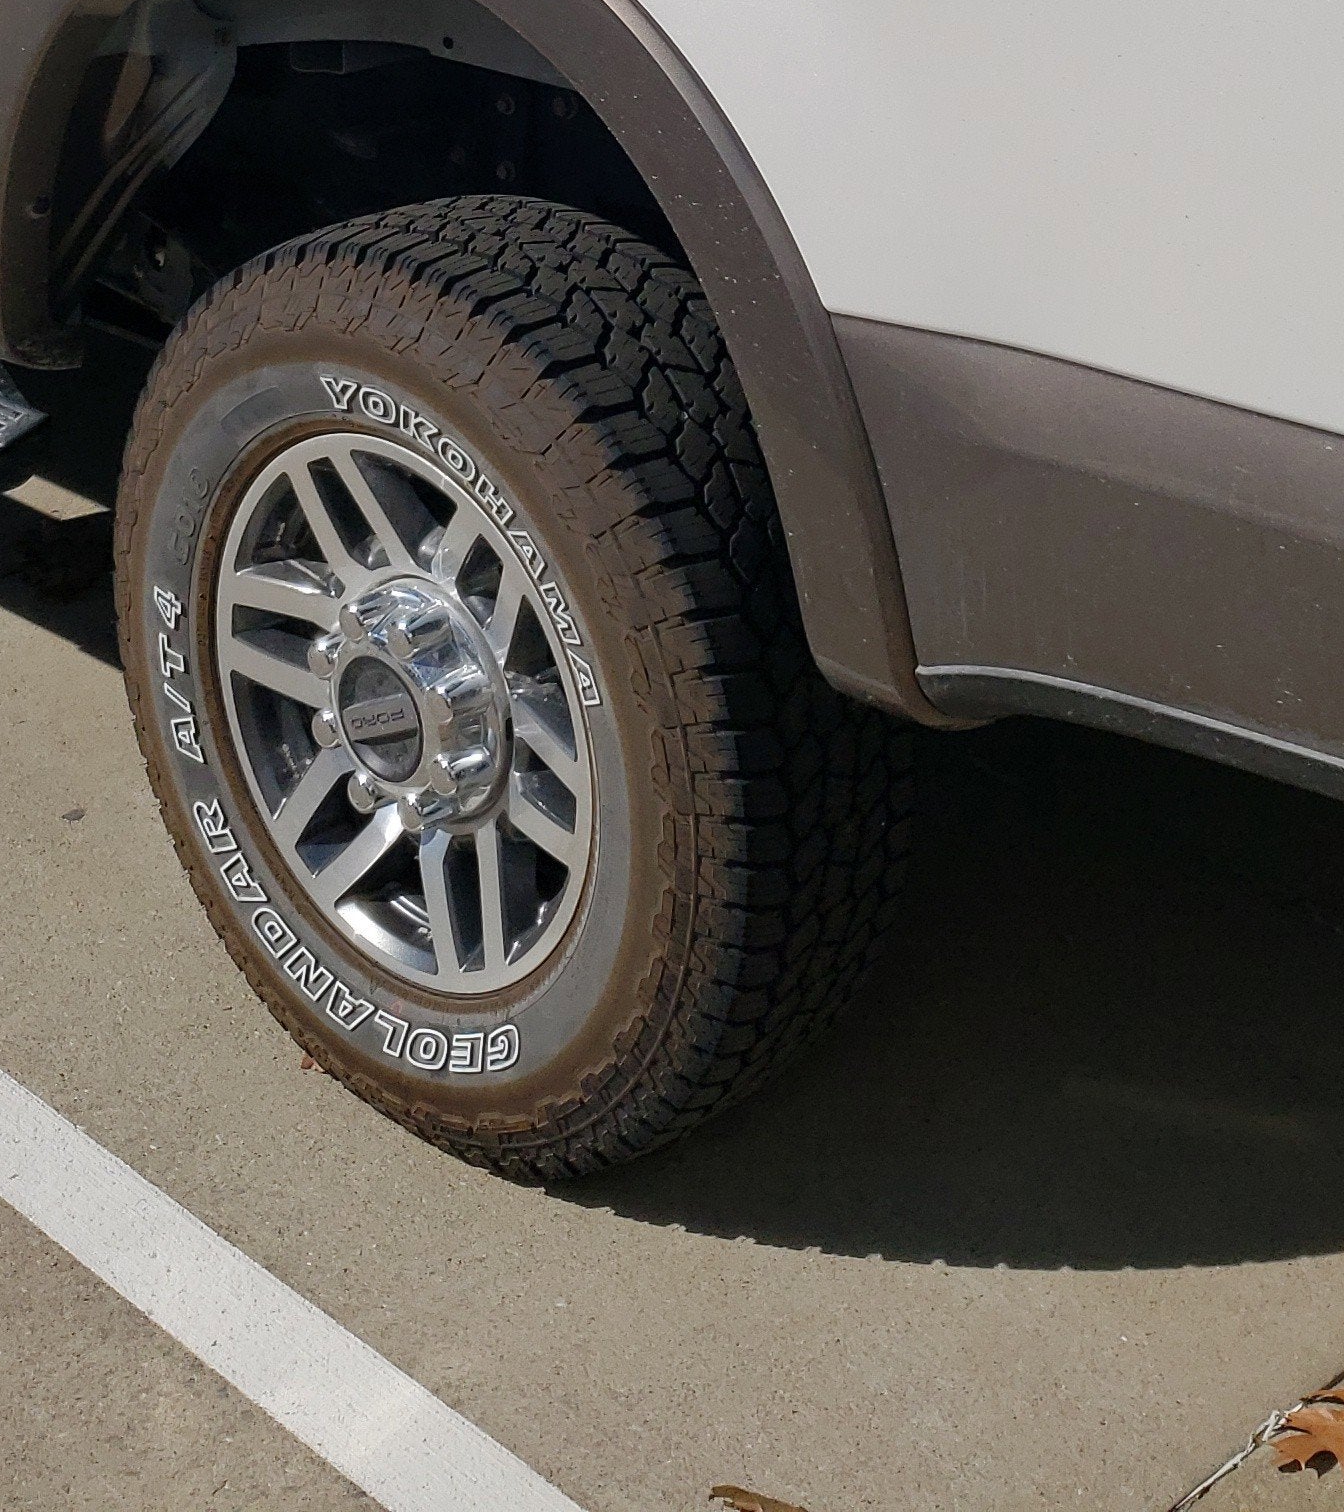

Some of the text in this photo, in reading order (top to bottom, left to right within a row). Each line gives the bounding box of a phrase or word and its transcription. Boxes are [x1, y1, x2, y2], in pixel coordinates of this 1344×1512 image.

[319, 373, 604, 709] YOKOHAMA
[152, 584, 207, 766] A/T4
[351, 707, 405, 730] FORD
[186, 798, 522, 1075] GEOLANDAR
